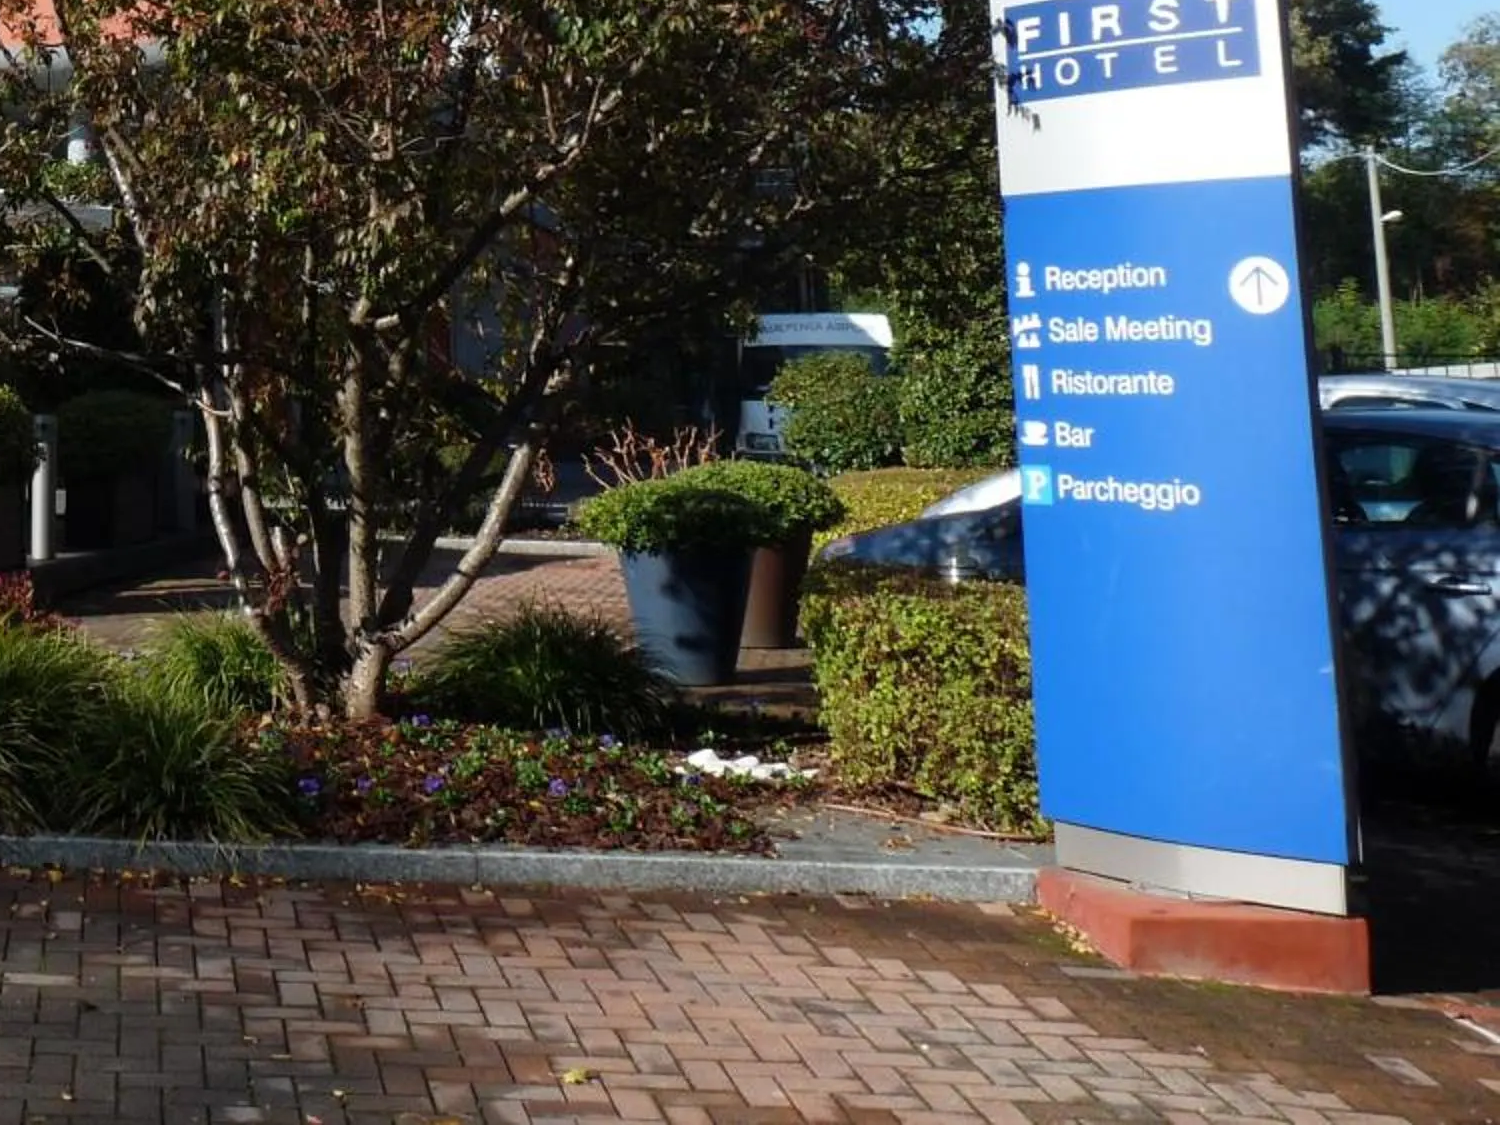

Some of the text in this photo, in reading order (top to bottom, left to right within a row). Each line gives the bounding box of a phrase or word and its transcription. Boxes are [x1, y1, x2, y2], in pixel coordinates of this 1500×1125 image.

[1021, 39, 1242, 90] HOTEL
[1045, 262, 1167, 294] Reception
[1049, 314, 1213, 346] Sale Meeting
[1052, 370, 1175, 396] Ristorante
[1054, 422, 1095, 447] Bar
[1057, 474, 1201, 510] Parcheggio
